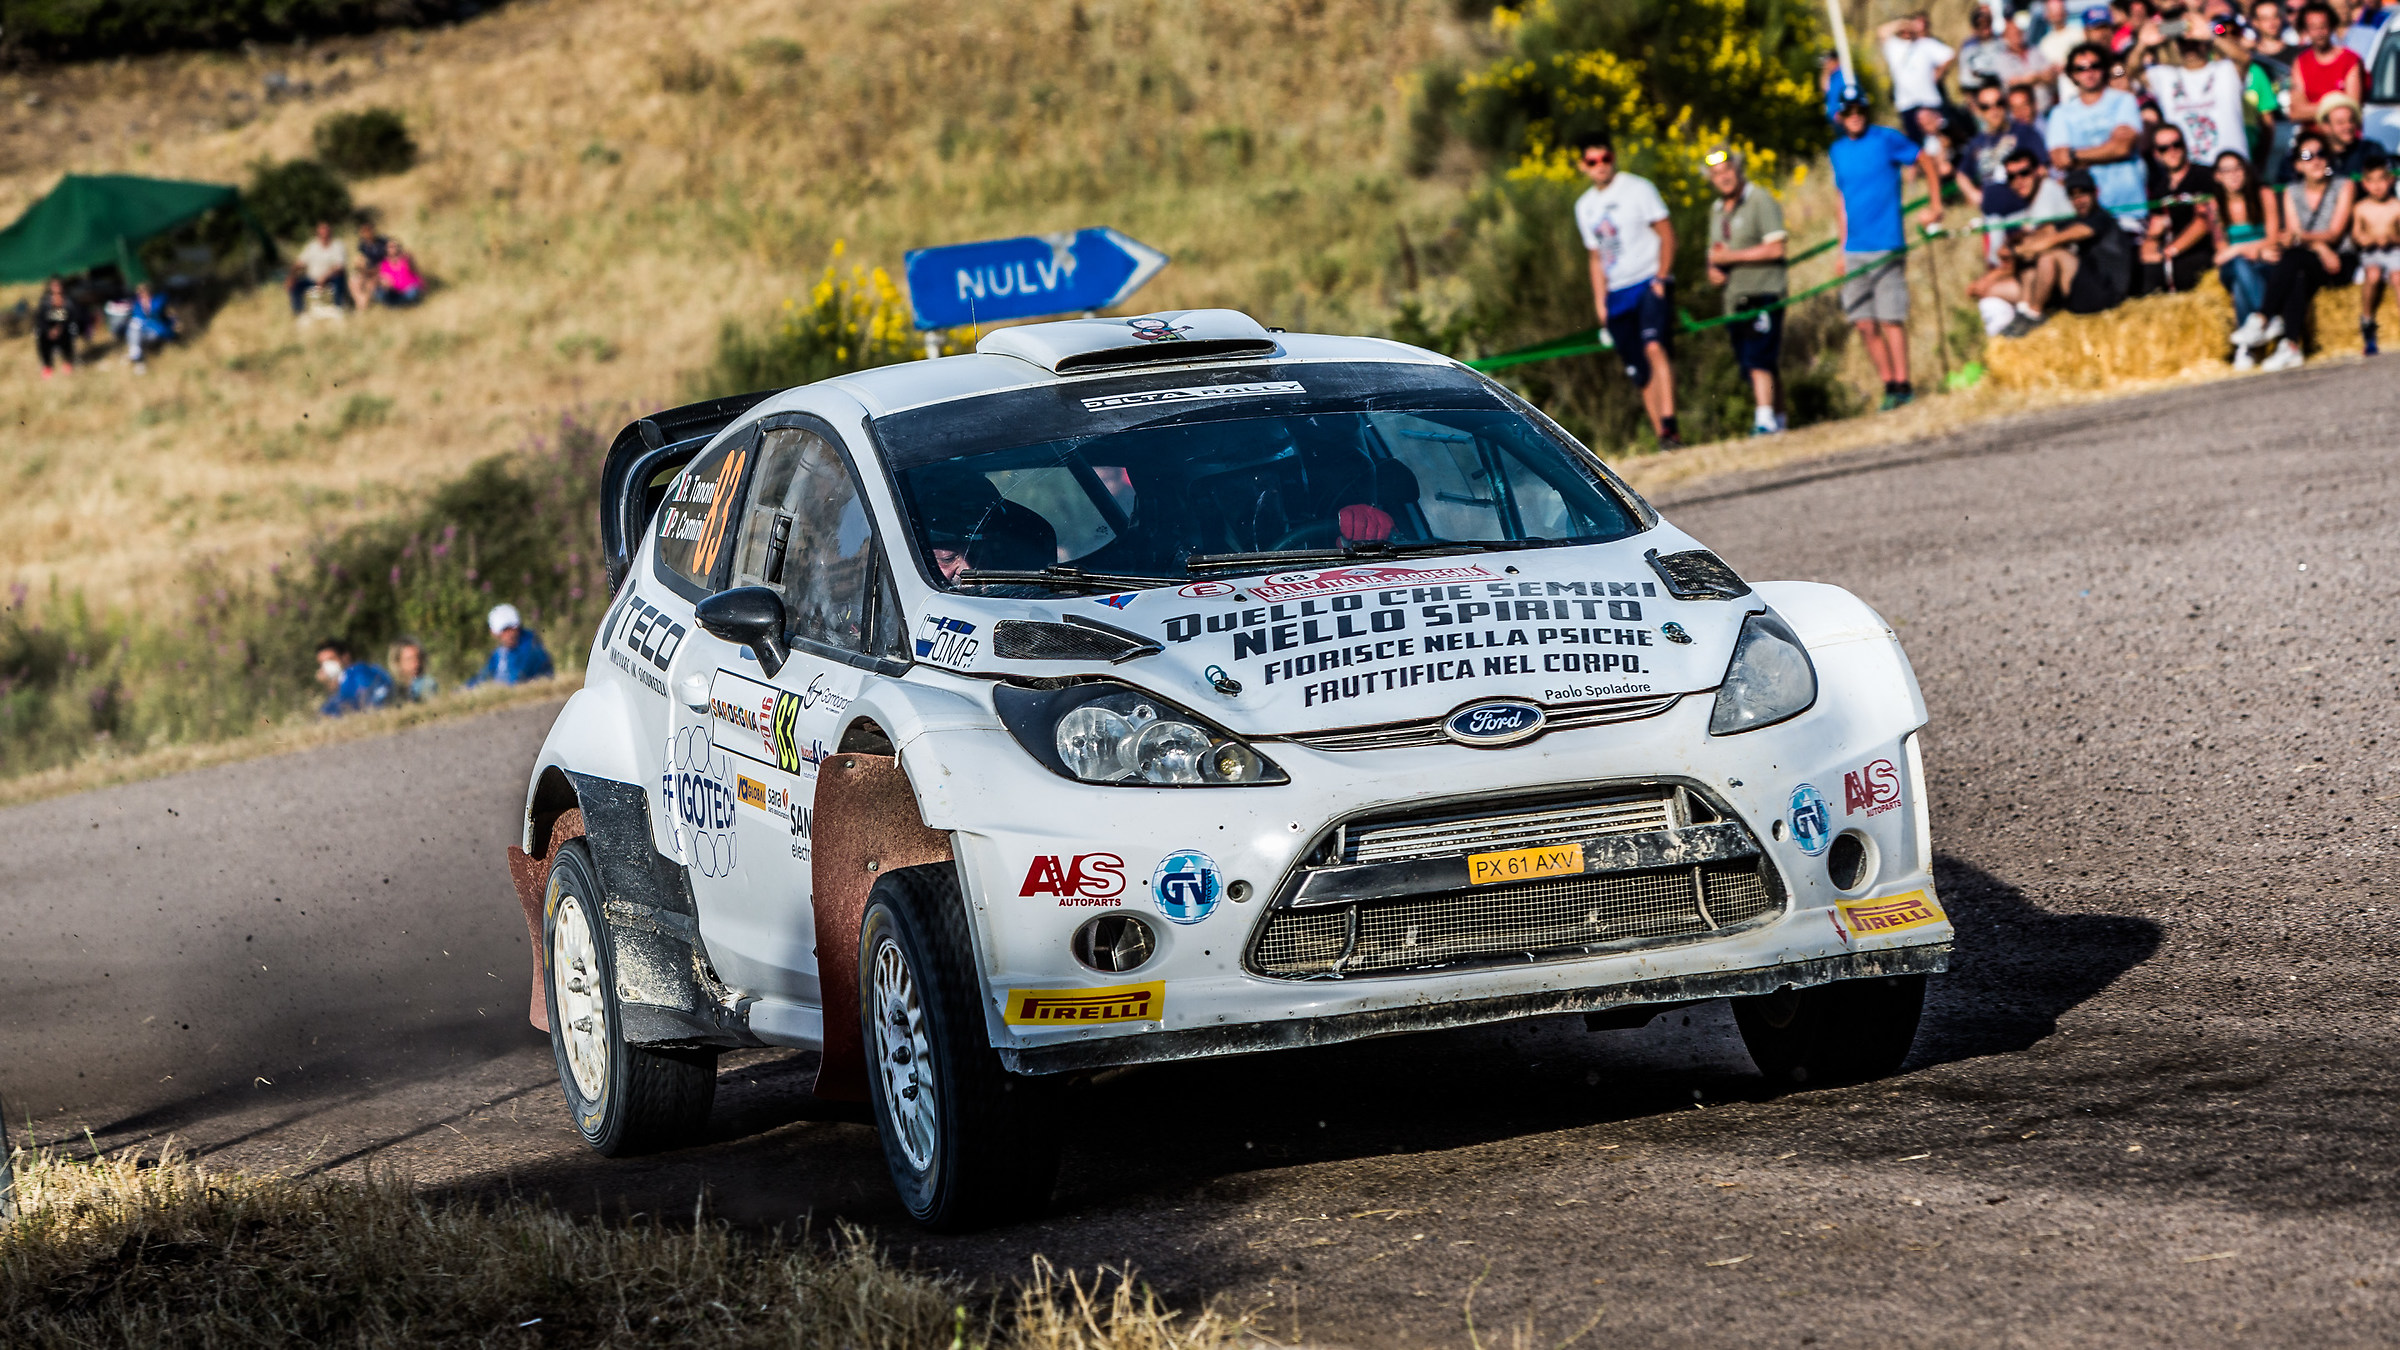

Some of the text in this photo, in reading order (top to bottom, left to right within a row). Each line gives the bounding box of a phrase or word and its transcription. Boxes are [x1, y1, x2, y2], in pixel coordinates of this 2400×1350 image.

[1083, 384, 1299, 408] DELTA RALLY
[688, 475, 718, 504] Tononi
[676, 511, 707, 541] Comini
[692, 450, 746, 576] 83
[1263, 580, 1325, 598] RALLY
[1321, 575, 1384, 589] ITALIA
[1385, 566, 1482, 583] SARDEGNA
[1280, 574, 1309, 583] 83
[1160, 594, 1363, 644] QUELLO
[1378, 584, 1472, 606] CHE
[1487, 581, 1657, 598] SEMINI
[1233, 600, 1643, 661] NELLO SPIRITO
[1264, 627, 1654, 686] FIORISCE NELLA PSICHE
[1304, 653, 1650, 708] FRUTTIFICA NEL CORPO.
[1544, 682, 1651, 701] Paolo Spoladore
[711, 697, 760, 733] SARDEGNA
[760, 696, 775, 755] 2016
[1469, 708, 1523, 733] Ford
[776, 692, 798, 772] 83
[748, 784, 766, 804] GLOBAL
[768, 788, 781, 808] sara
[1844, 759, 1900, 816] AVS
[1866, 799, 1902, 818] AUTOPARTS
[1018, 852, 1126, 899] AVS
[1476, 851, 1574, 878] PX 61 AXV
[1058, 898, 1122, 908] AUTOPARTS
[1846, 900, 1934, 932] PIRELLI
[1020, 990, 1152, 1019] PIRELLI
